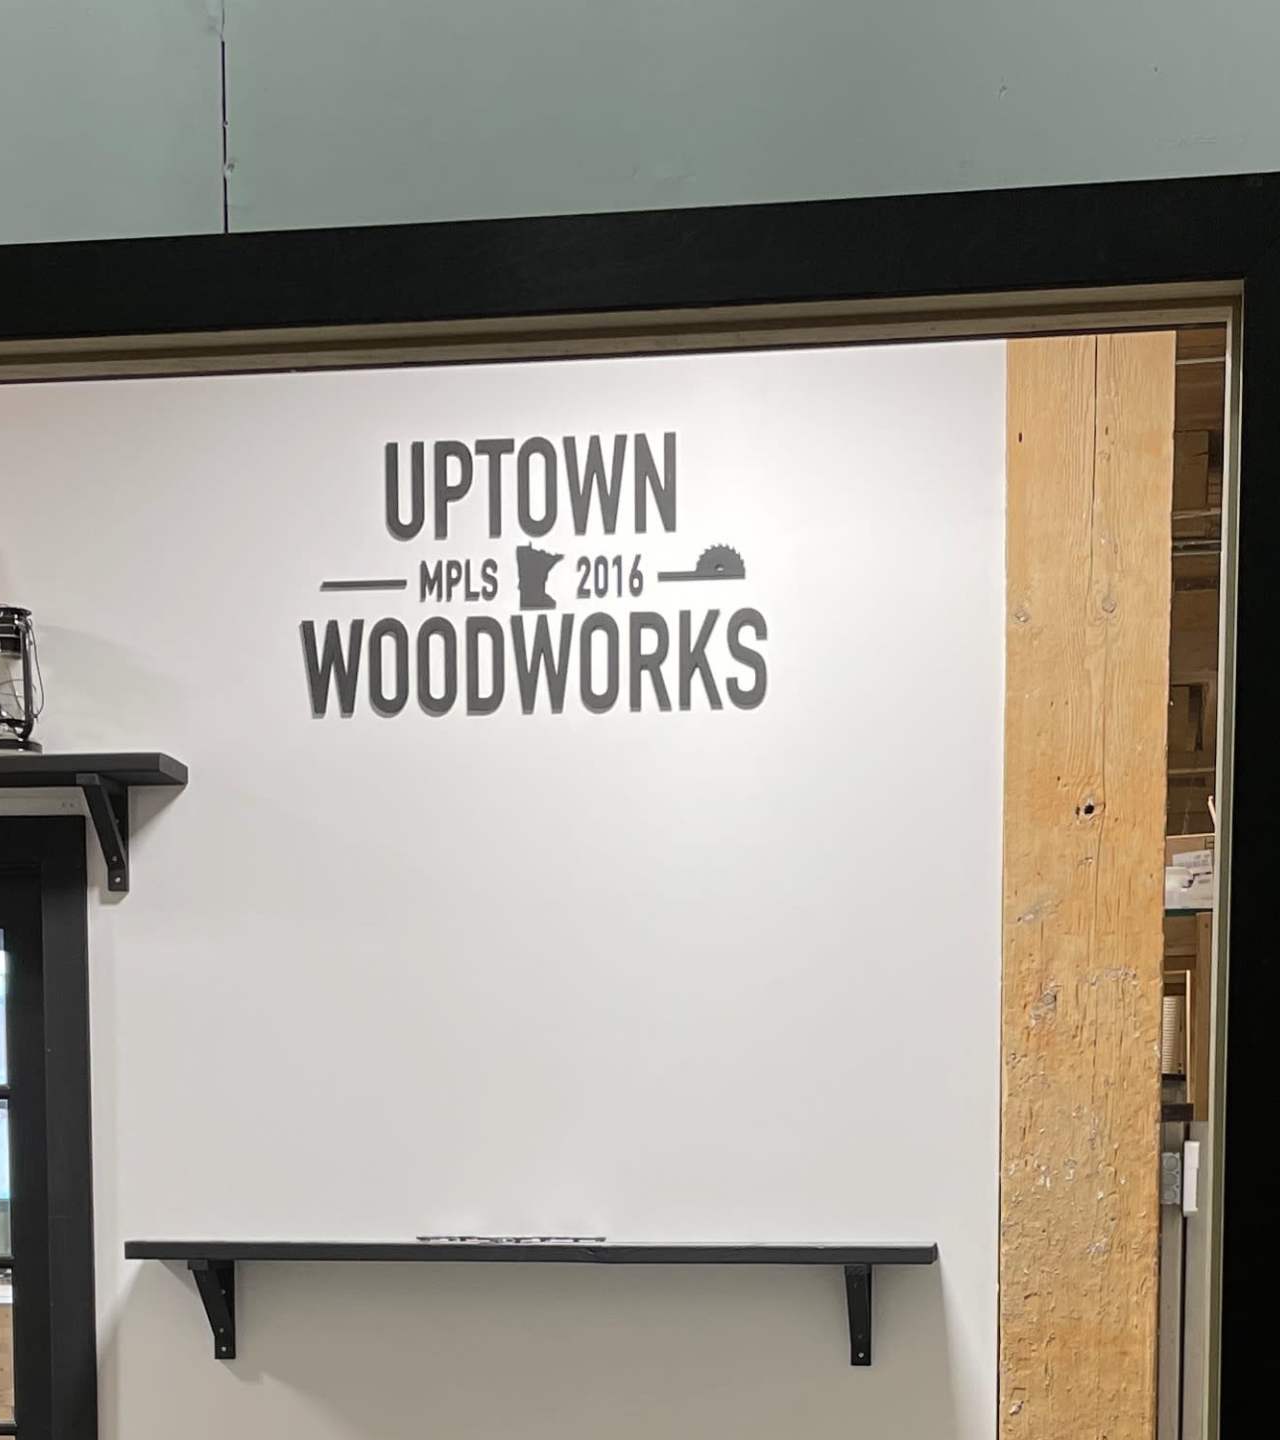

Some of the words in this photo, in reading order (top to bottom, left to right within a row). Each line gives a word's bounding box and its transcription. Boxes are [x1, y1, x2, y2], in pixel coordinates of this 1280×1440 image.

[384, 431, 677, 541] UPTOWN
[419, 559, 499, 602] MPLS
[575, 554, 644, 599] 2016
[300, 607, 768, 718] WOODWORKS
